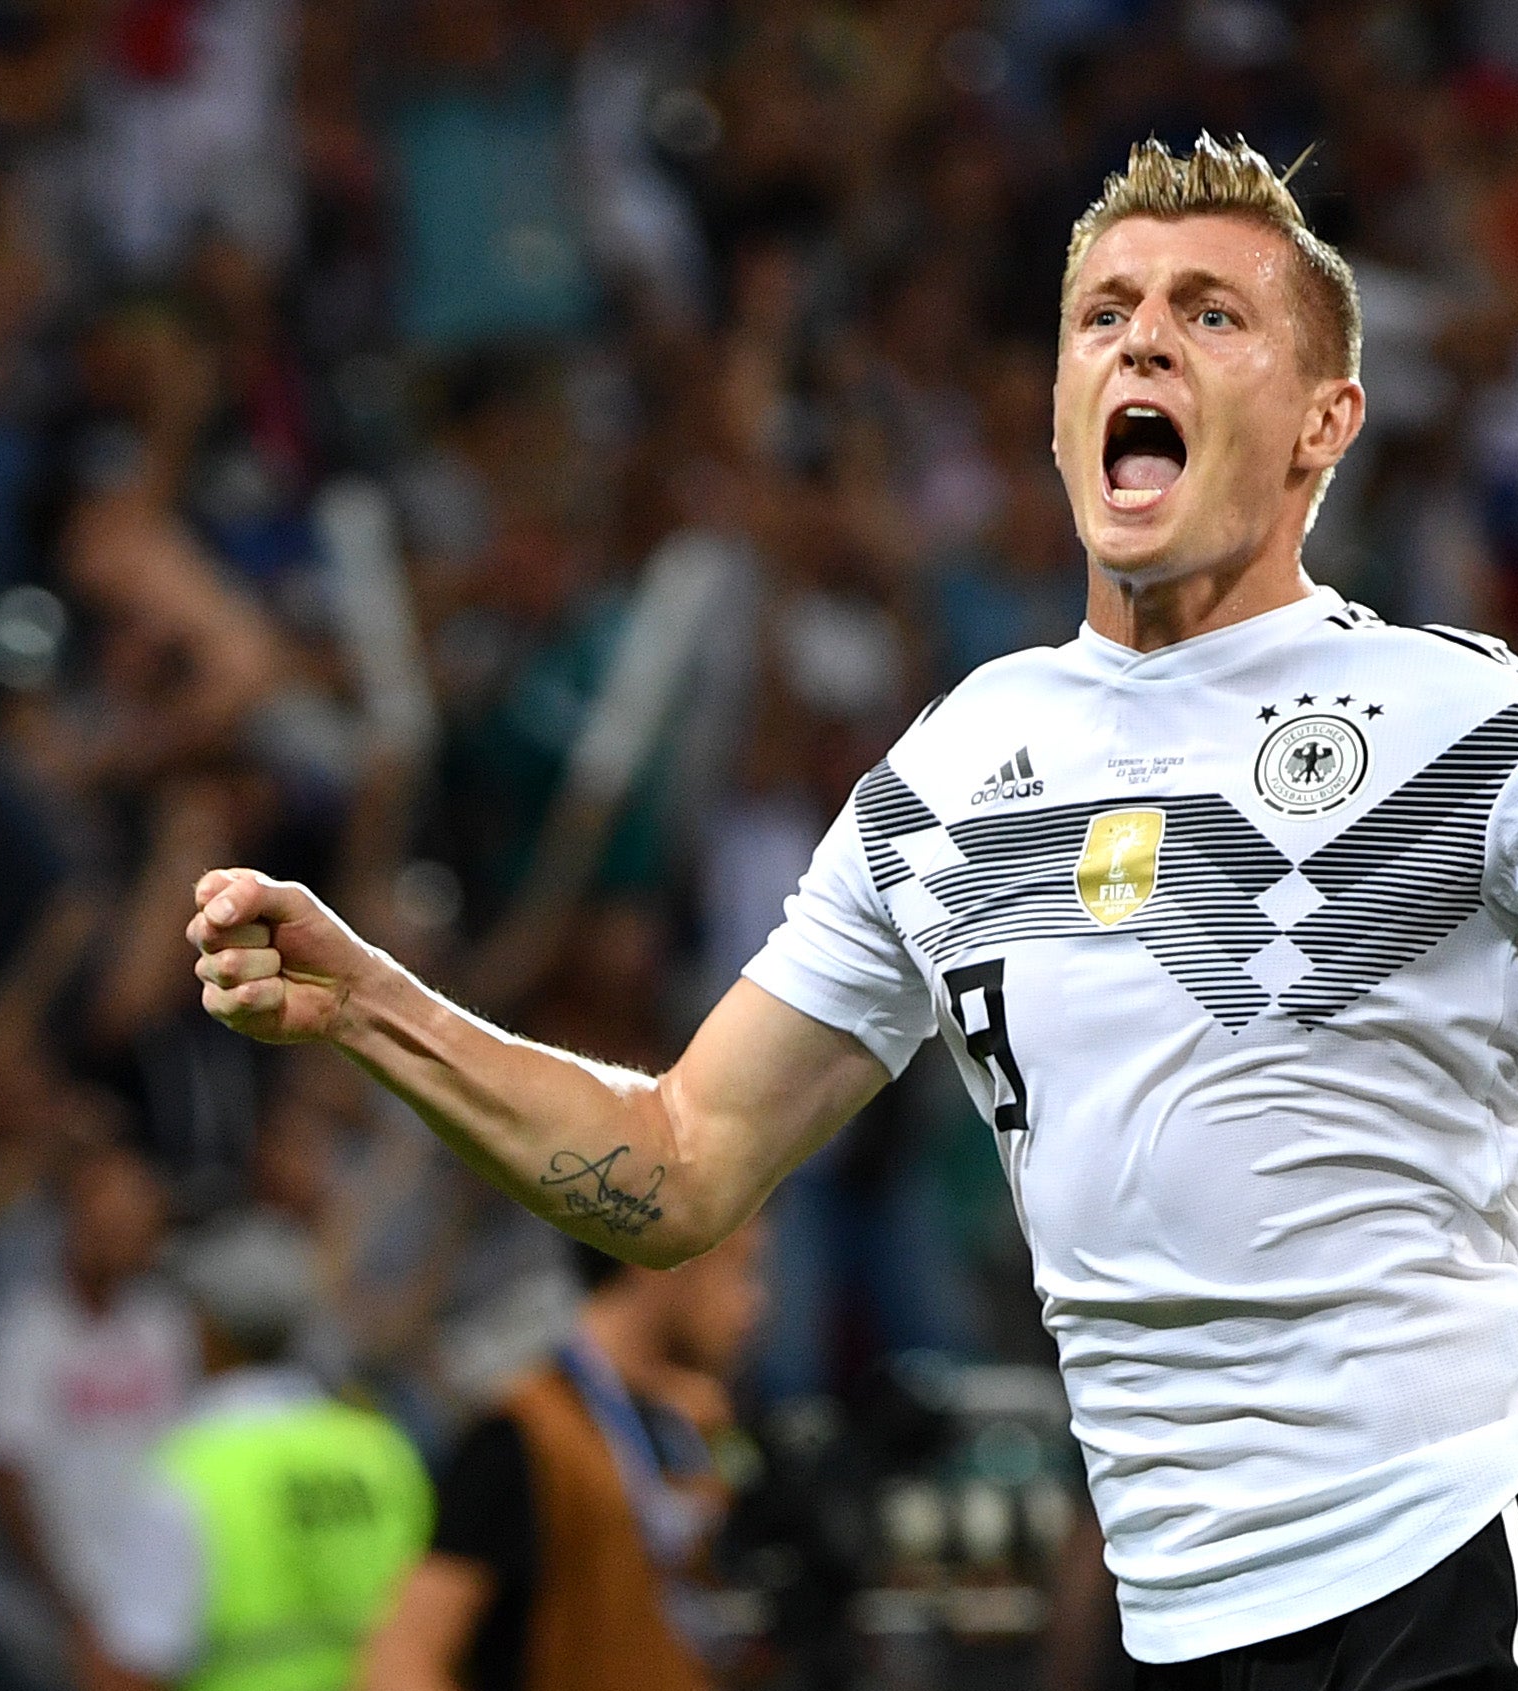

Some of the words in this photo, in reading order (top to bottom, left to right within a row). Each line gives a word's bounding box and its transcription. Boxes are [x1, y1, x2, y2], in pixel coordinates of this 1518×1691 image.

[1282, 725, 1346, 746] DEUTSCHER
[970, 778, 1044, 806] adidas
[1271, 775, 1347, 802] FUSSBALL-BUND
[1099, 883, 1136, 901] FIFA
